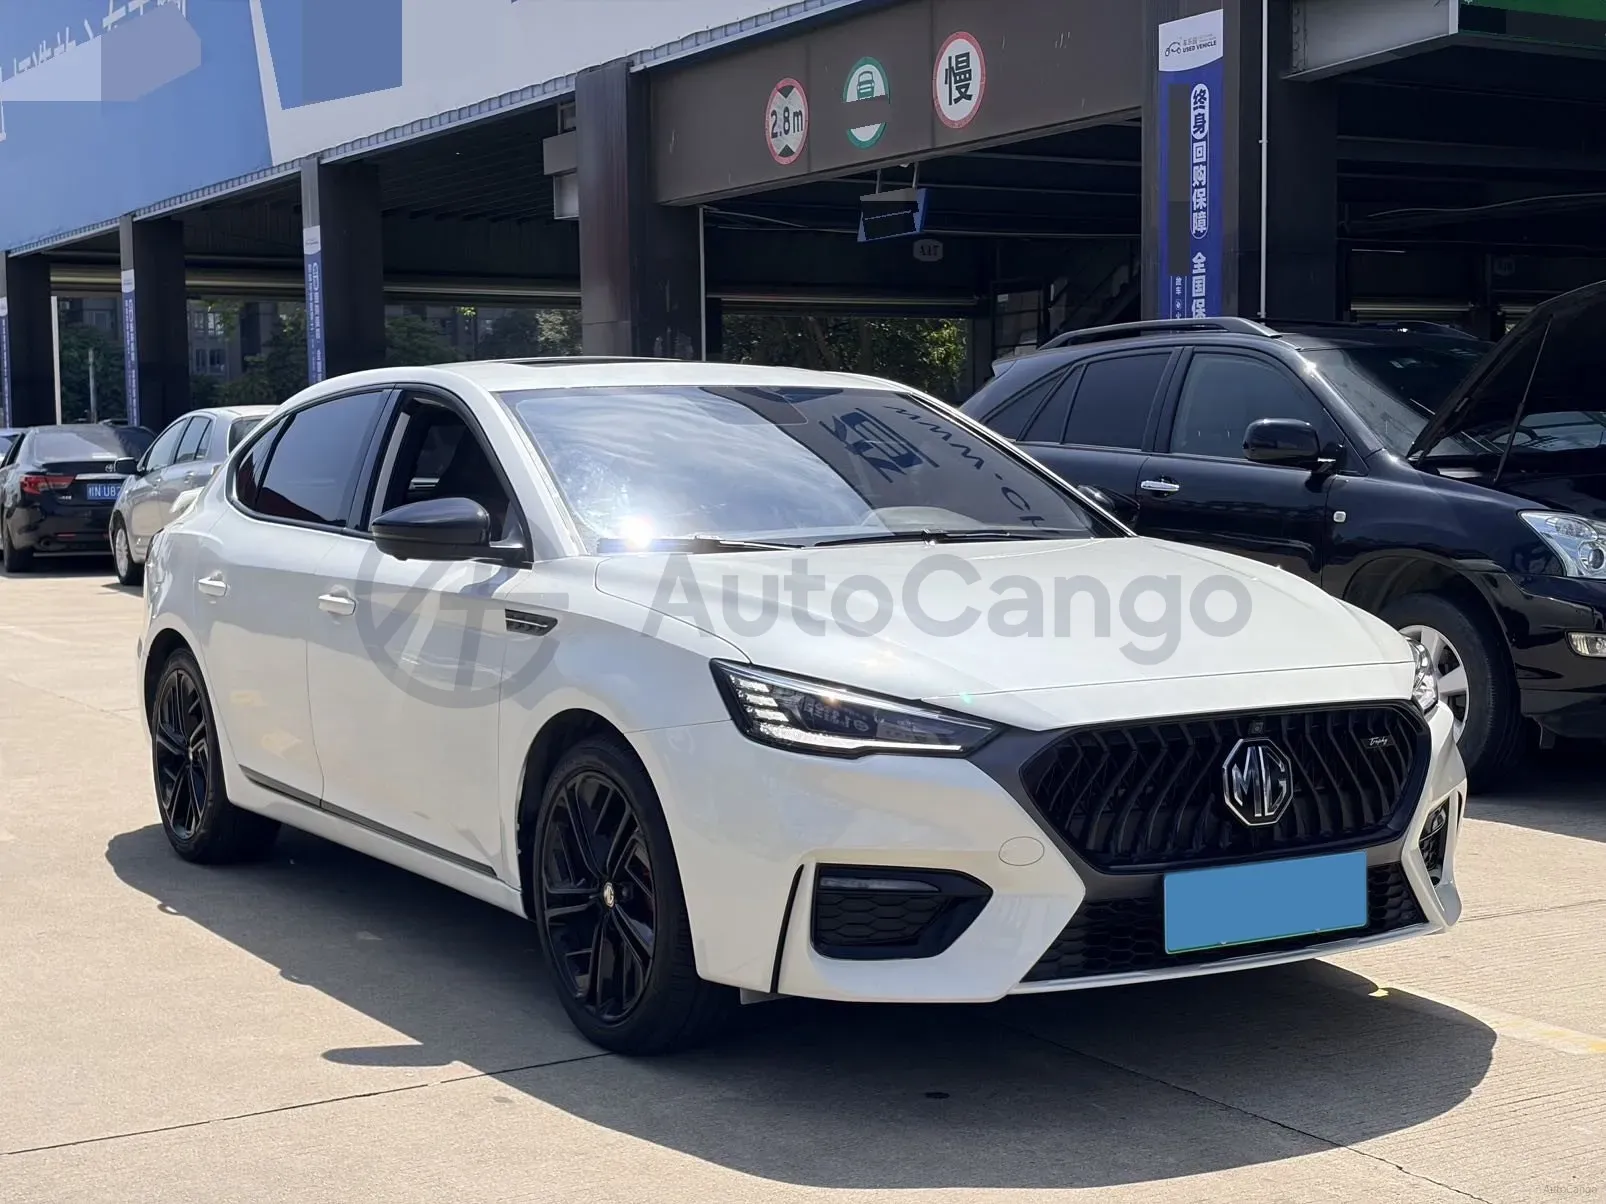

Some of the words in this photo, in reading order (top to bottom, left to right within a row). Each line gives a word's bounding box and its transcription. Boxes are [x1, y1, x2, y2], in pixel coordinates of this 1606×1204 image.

[1183, 45, 1195, 53] USED
[1197, 40, 1216, 50] VEHICLE
[944, 51, 973, 106] 慢
[1231, 745, 1287, 818] MG
